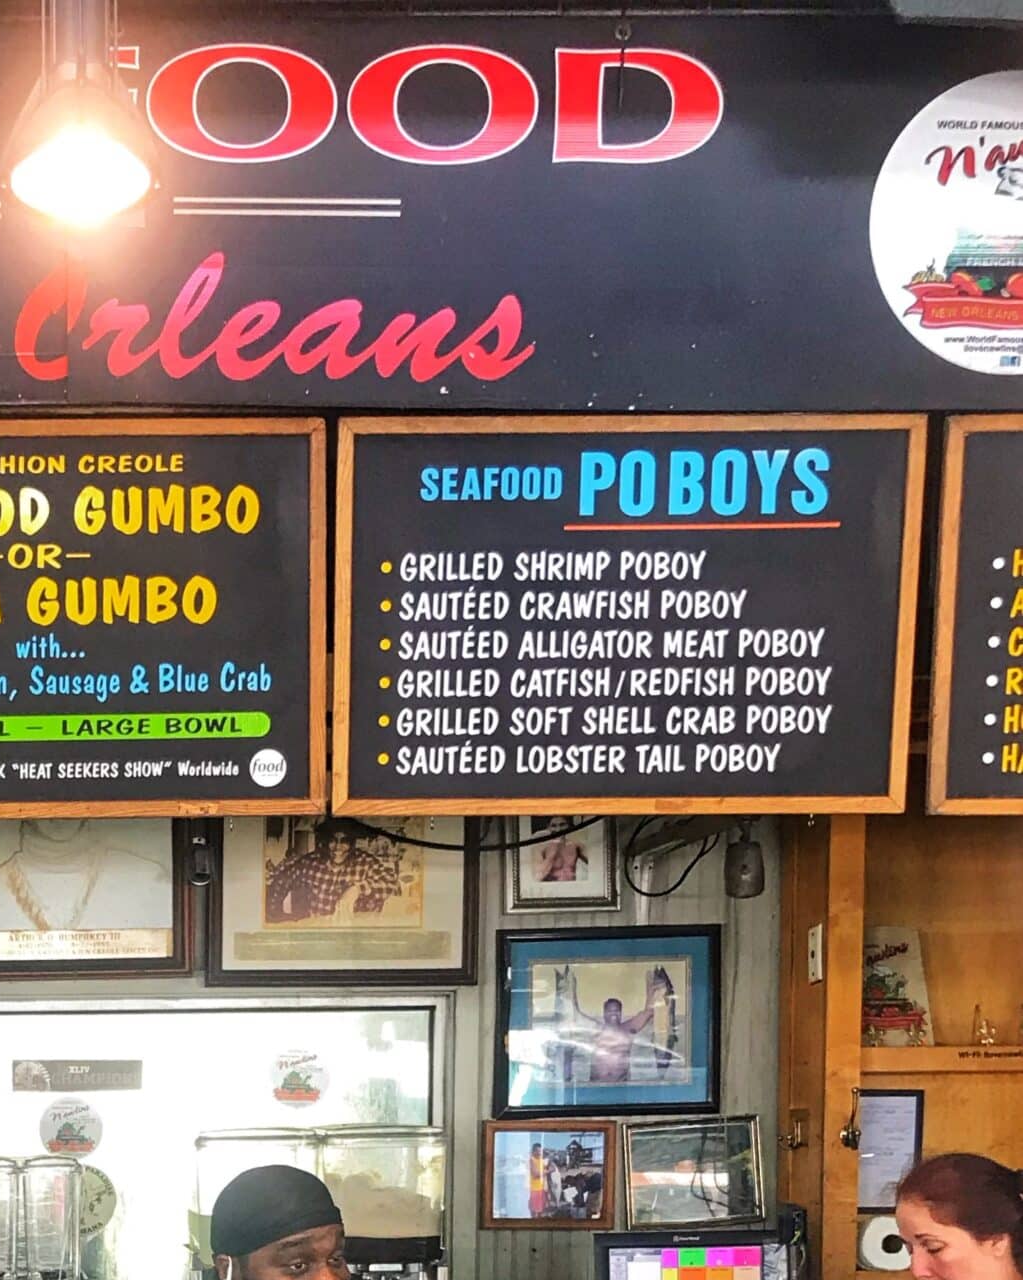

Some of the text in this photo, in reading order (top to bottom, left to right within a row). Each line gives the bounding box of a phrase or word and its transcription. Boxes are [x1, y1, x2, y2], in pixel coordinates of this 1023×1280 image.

[109, 43, 724, 166] OOD
[937, 120, 977, 129] WORLD
[14, 251, 536, 383] Orleans
[961, 306, 1019, 320] ORLEANS
[77, 453, 184, 475] CREOLE
[419, 447, 831, 517] SEAFOOD PO BOYS
[73, 483, 260, 536] GUMBO
[399, 549, 707, 583] GRILLED SHRIMP POBOY
[26, 574, 218, 627] GUMBO
[398, 585, 748, 622] SAUTÉED CRAWFISH POBOY
[15, 632, 86, 659] with...
[397, 624, 826, 661] SAUTÉED ALLIGATOR MEAT POBOY
[28, 664, 121, 703] Sausage
[129, 664, 150, 694] &
[158, 662, 209, 693] Blue
[219, 661, 272, 693] Crab
[396, 665, 833, 699] GRILLED CATFISH/REDFISH POBOY
[61, 719, 151, 737] LARGE
[165, 717, 243, 735] BOWL
[396, 704, 833, 737] GRILLED SOFT SHELL CRAB POBOY
[11, 762, 53, 780] “HEAT
[57, 761, 119, 779] SEEKERS
[123, 760, 172, 778] SHOW”
[177, 759, 240, 777] Worldwide
[251, 758, 284, 776] food
[395, 740, 781, 776] SAUTÉED LOBSTER TAIL POBOY
